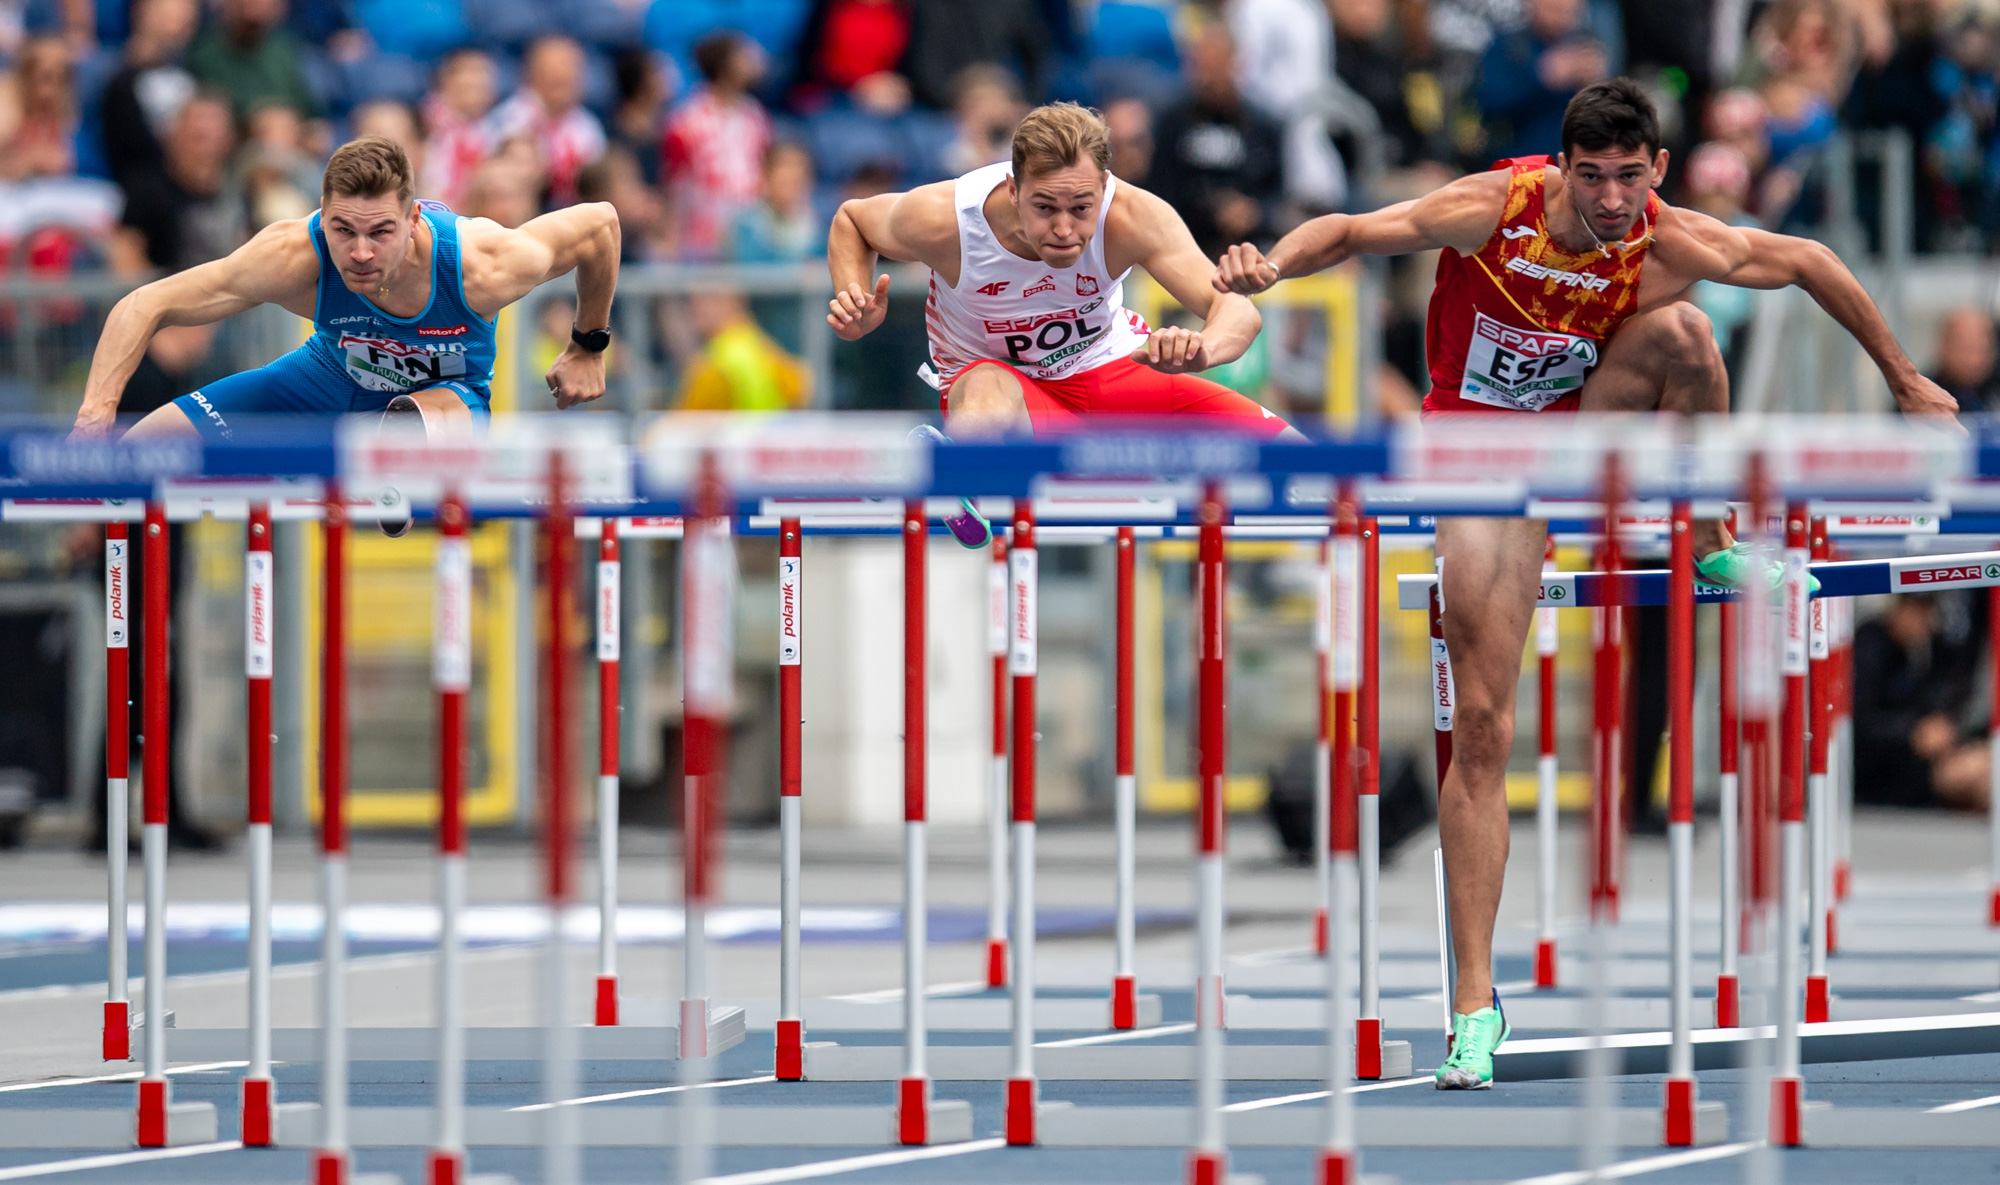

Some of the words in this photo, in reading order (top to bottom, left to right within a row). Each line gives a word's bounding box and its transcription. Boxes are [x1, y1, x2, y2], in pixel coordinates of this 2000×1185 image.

[976, 281, 1010, 295] 4F
[1505, 256, 1611, 292] ESPAÑA
[329, 316, 373, 325] CRAFT
[987, 309, 1076, 332] SPAR
[1004, 318, 1102, 359] POL
[1479, 319, 1568, 356] SPAR
[367, 344, 441, 379] FIN
[1053, 340, 1090, 360] CLEAN
[1489, 347, 1568, 386] ESP
[1519, 380, 1555, 394] CLEAN
[189, 390, 228, 428] CRAFT
[1919, 567, 1981, 581] SPAR
[109, 565, 125, 621] polanik
[782, 582, 797, 638] polanik
[1434, 661, 1452, 707] polanik
